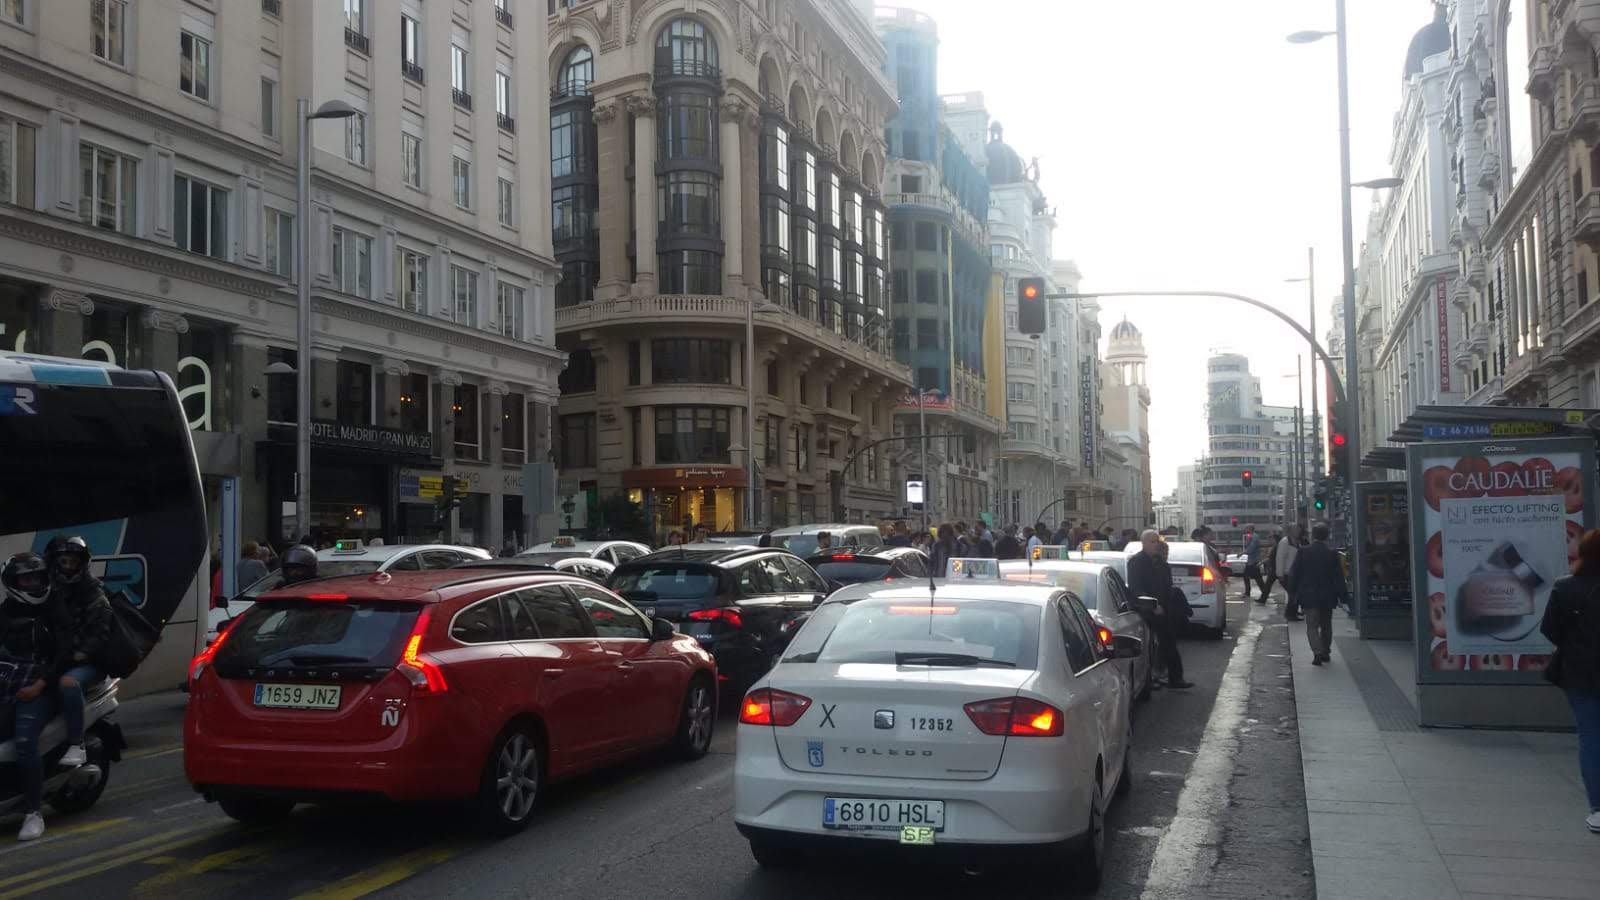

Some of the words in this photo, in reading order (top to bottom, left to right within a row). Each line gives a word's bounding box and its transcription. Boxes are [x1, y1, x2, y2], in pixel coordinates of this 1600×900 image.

[1082, 375, 1091, 411] HOTEL
[340, 425, 378, 442] MADRID
[379, 431, 404, 446] GRAN
[420, 435, 431, 449] 25
[1440, 427, 1447, 436] 2
[1471, 504, 1514, 514] EFECTO
[1517, 503, 1560, 513] LIFTING
[247, 670, 340, 678] VOLVO
[267, 687, 302, 703] 1659
[307, 688, 337, 705] JNZ
[818, 703, 837, 728] X
[910, 717, 954, 731] 12352
[839, 746, 935, 757] TOLEDO
[839, 803, 890, 823] 6810
[898, 803, 936, 824] HSL
[903, 829, 931, 842] SP
